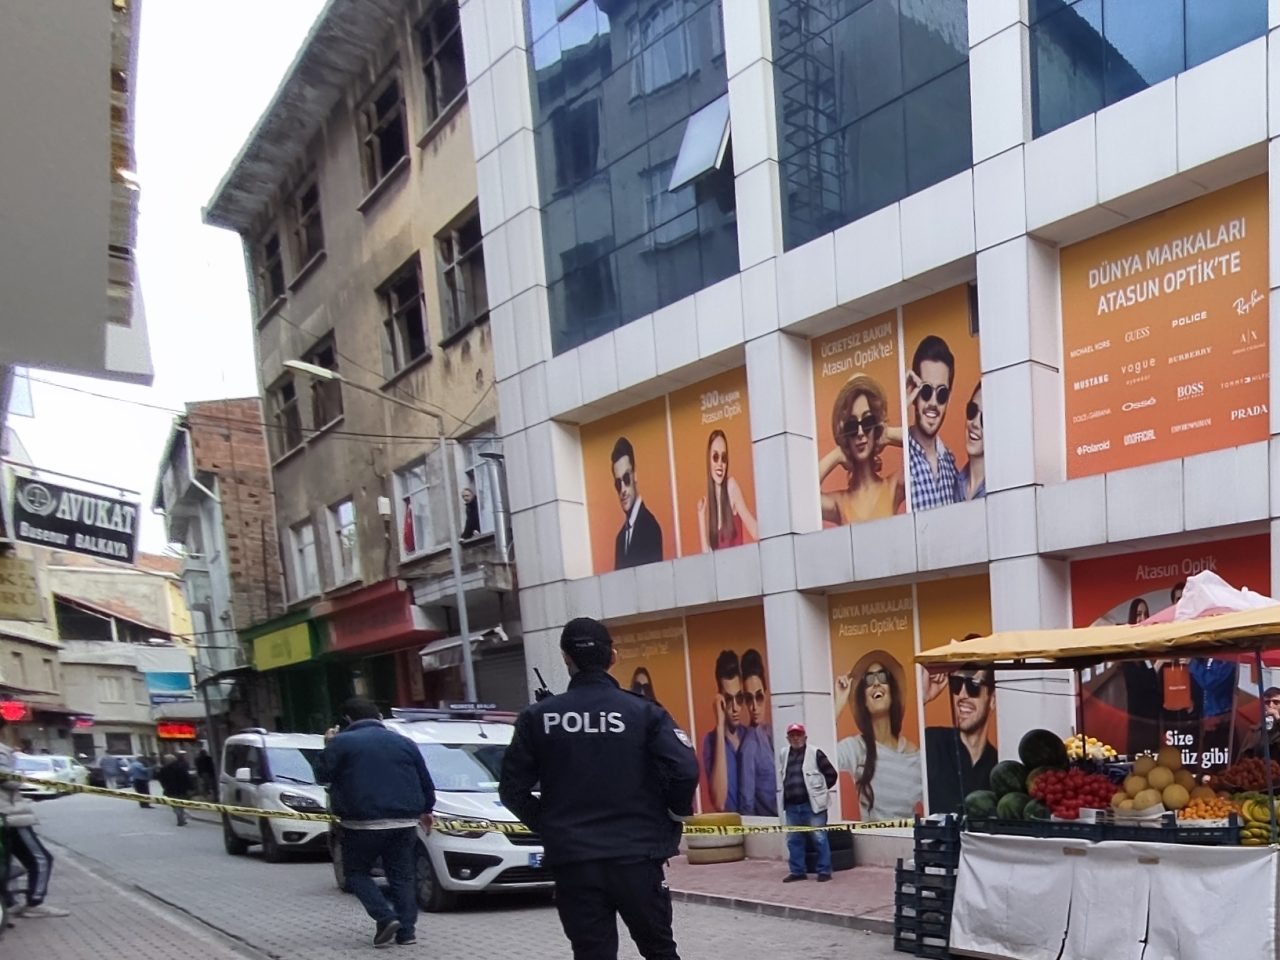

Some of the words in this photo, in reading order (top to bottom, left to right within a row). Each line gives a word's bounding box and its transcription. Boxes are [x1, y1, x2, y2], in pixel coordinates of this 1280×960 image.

[1089, 255, 1143, 289] DÜNYA
[1146, 217, 1246, 270] MARKALARI
[1097, 278, 1159, 315] ATASUN
[1172, 311, 1208, 328] POLICE
[1125, 326, 1150, 342] GUESS
[1168, 346, 1212, 364] BURBERRY
[822, 357, 853, 377] Atasun
[1121, 357, 1156, 374] vogue
[1073, 374, 1109, 391] MUSTANG
[1177, 382, 1204, 398] BOSS
[1231, 404, 1268, 421] PRADA
[1082, 440, 1110, 455] Polaroid
[55, 491, 136, 534] AVUKAT
[75, 533, 128, 558] BALKAYA
[1136, 562, 1179, 581] Atasun
[1182, 556, 1217, 575] Optik
[1166, 730, 1195, 746] Size
[1201, 748, 1228, 768] gibi
